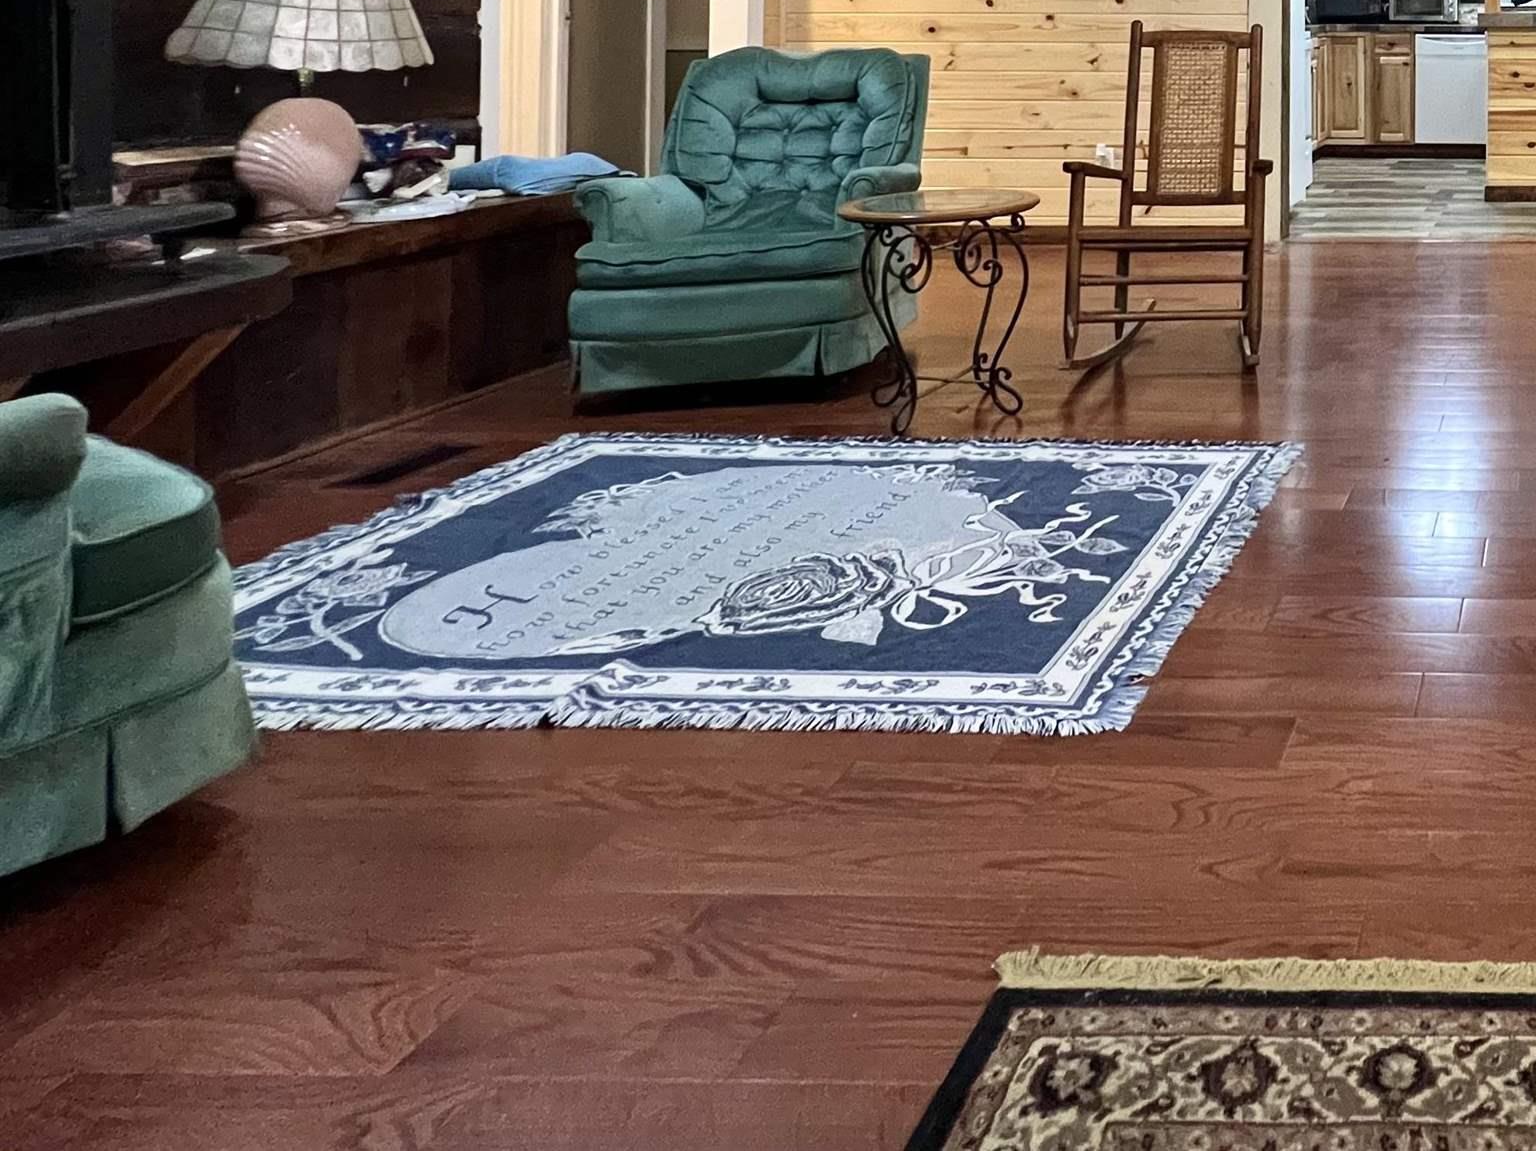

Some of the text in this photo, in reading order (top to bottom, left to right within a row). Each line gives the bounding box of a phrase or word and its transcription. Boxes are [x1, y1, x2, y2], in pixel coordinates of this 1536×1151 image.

[443, 564, 583, 630] How
[476, 611, 555, 651] how
[562, 526, 701, 607] fortunate
[553, 600, 628, 640] that
[632, 566, 684, 597] you
[688, 537, 728, 562] are
[728, 513, 772, 533] my
[675, 511, 826, 607] and also my
